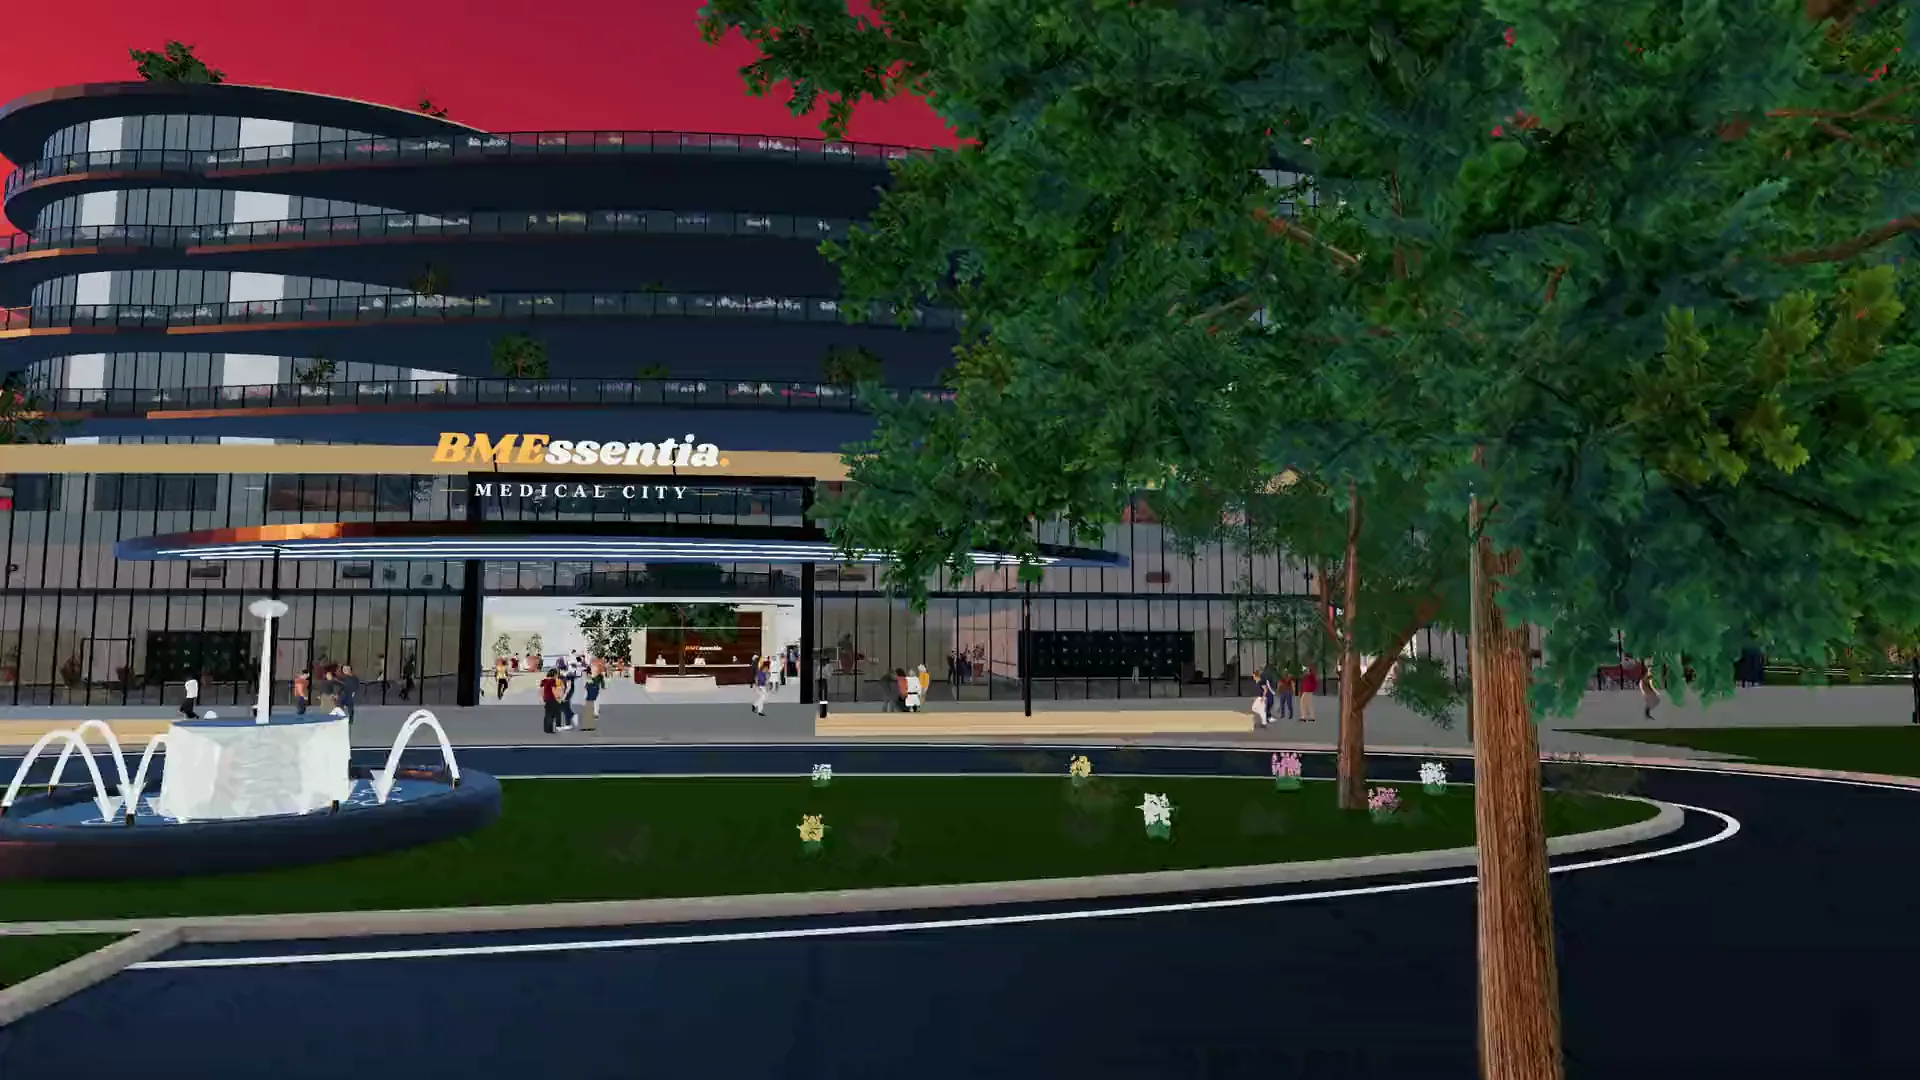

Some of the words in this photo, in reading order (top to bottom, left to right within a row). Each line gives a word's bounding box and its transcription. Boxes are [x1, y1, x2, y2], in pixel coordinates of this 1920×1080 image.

[432, 432, 730, 467] BMEssentia.
[474, 483, 606, 498] MEDICAL
[622, 486, 689, 500] CITY
